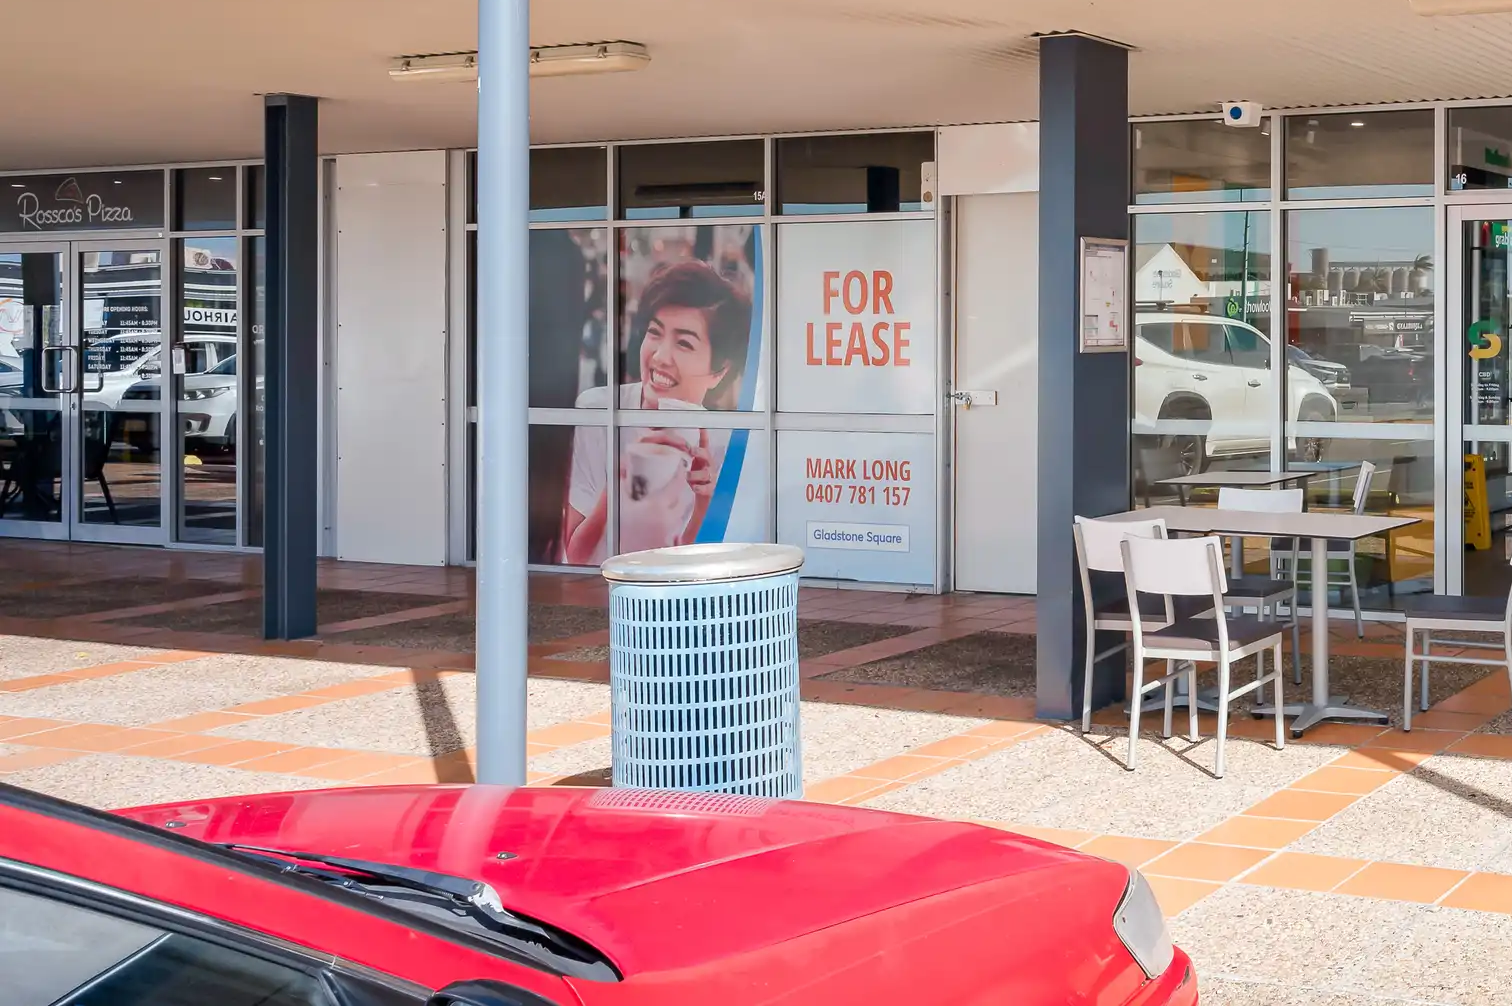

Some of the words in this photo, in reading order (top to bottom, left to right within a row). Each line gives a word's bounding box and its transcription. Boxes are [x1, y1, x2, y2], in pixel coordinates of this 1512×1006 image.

[1455, 173, 1468, 185] 16
[17, 192, 83, 230] Rossco's
[86, 194, 134, 223] Pizza
[823, 269, 895, 316] FOR
[806, 321, 911, 367] LEASE
[806, 457, 857, 480] MARK
[862, 459, 911, 482] LONG
[806, 483, 843, 504] 0407
[848, 484, 876, 505] 781
[883, 486, 911, 507] 157
[813, 528, 865, 543] Gladstone
[866, 531, 902, 545] Square
